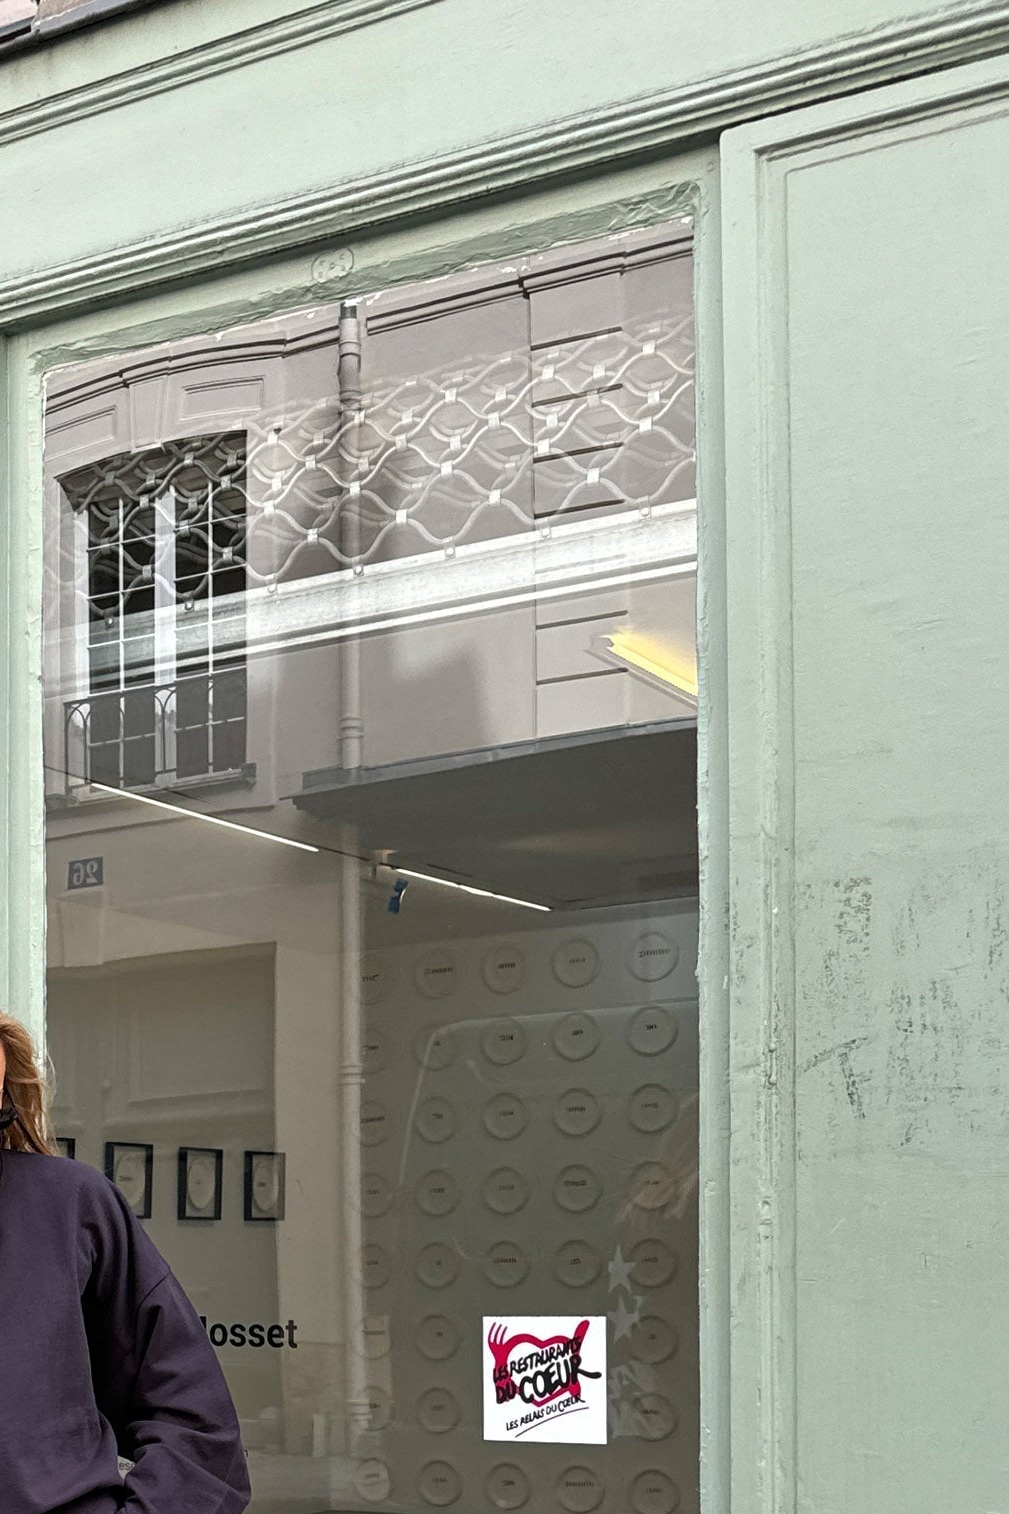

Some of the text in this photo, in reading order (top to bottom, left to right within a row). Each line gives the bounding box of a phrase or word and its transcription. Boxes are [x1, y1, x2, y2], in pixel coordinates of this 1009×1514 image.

[496, 1380, 517, 1404] DU
[506, 1420, 519, 1431] LES
[520, 1408, 544, 1426] RELAIS
[546, 1402, 558, 1416] DU
